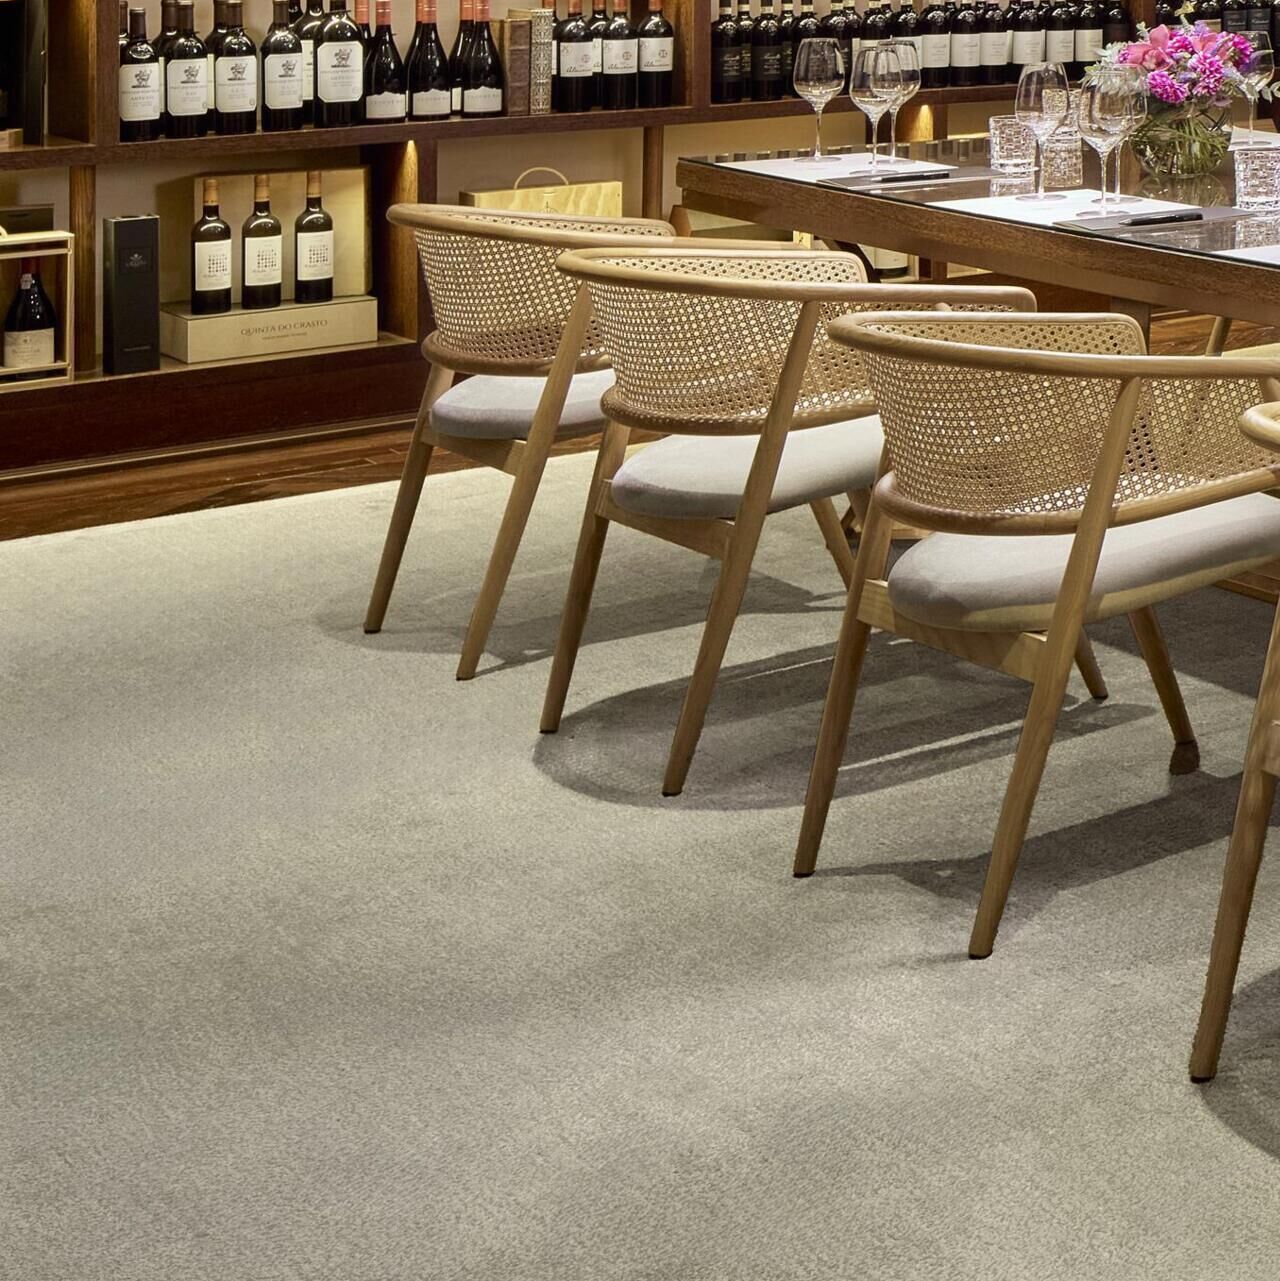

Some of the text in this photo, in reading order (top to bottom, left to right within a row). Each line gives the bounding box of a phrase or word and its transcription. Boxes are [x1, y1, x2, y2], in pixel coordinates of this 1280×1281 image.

[240, 324, 276, 336] QUINTA
[278, 322, 292, 331] DO
[293, 319, 328, 329] CRASTO
